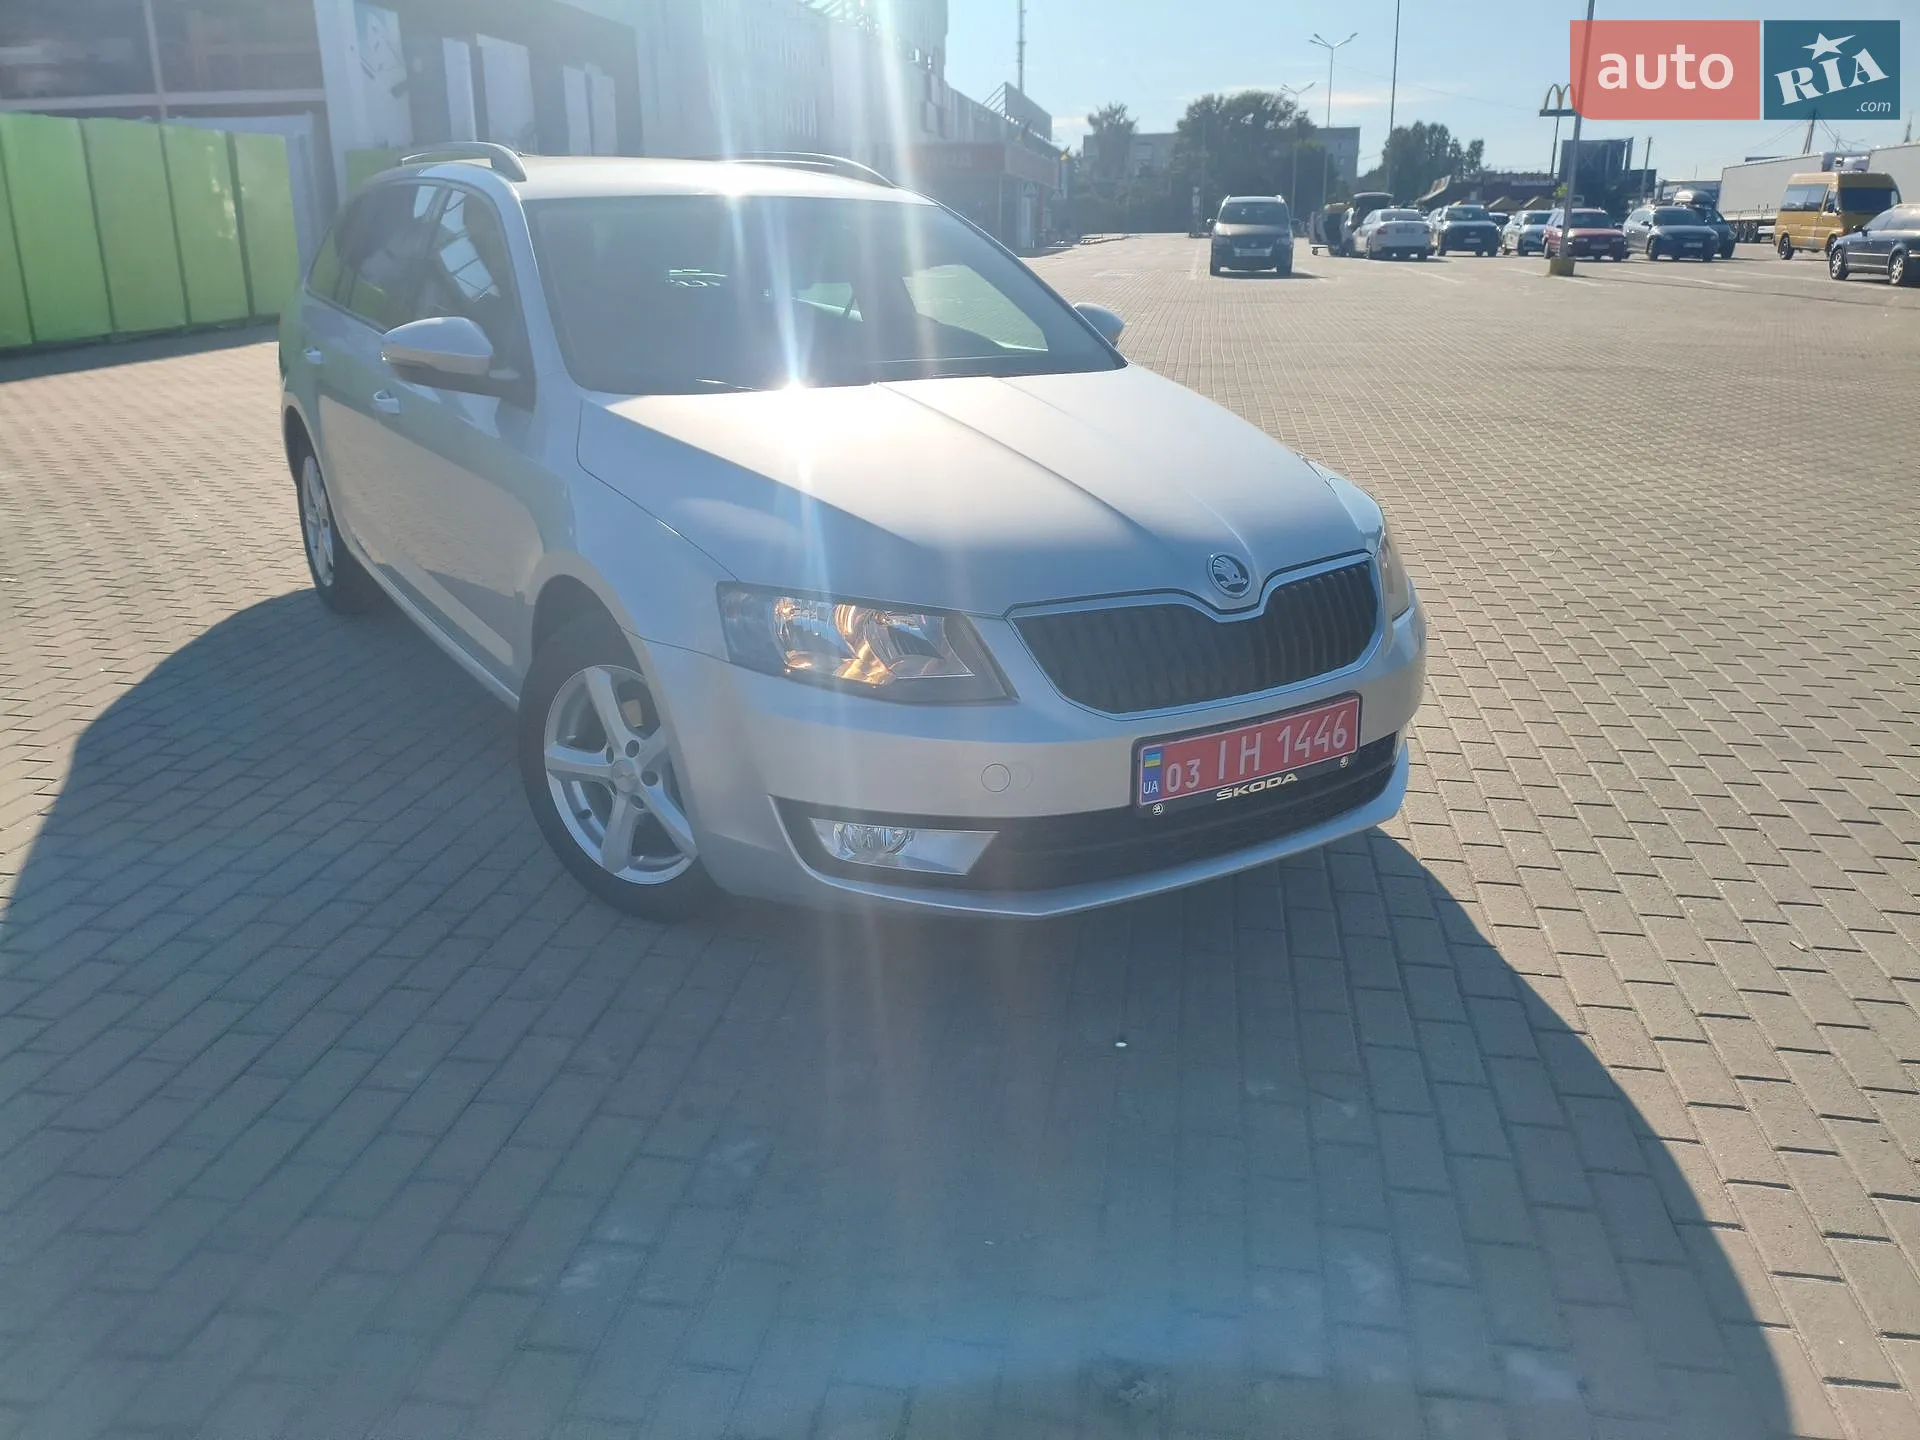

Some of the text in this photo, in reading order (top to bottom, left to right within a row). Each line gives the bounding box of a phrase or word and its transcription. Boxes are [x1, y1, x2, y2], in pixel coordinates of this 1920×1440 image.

[1166, 758, 1201, 793] 03
[1276, 710, 1349, 764] 1446
[1143, 780, 1159, 795] UA
